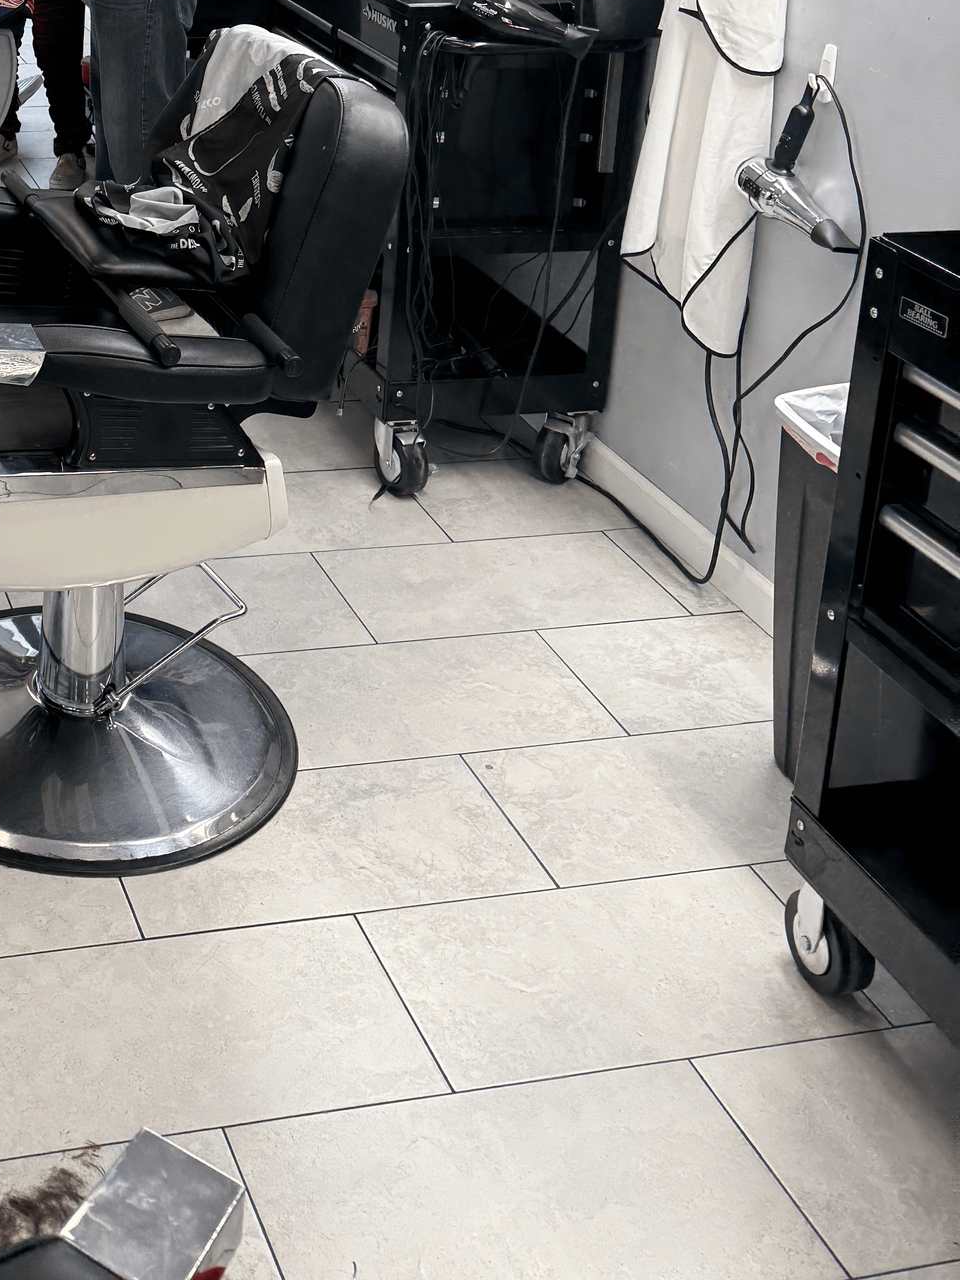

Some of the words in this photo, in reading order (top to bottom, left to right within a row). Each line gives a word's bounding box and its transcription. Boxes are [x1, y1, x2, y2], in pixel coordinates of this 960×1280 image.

[371, 8, 398, 33] HUSKY
[907, 308, 939, 329] BEARING
[914, 304, 933, 319] BALL
